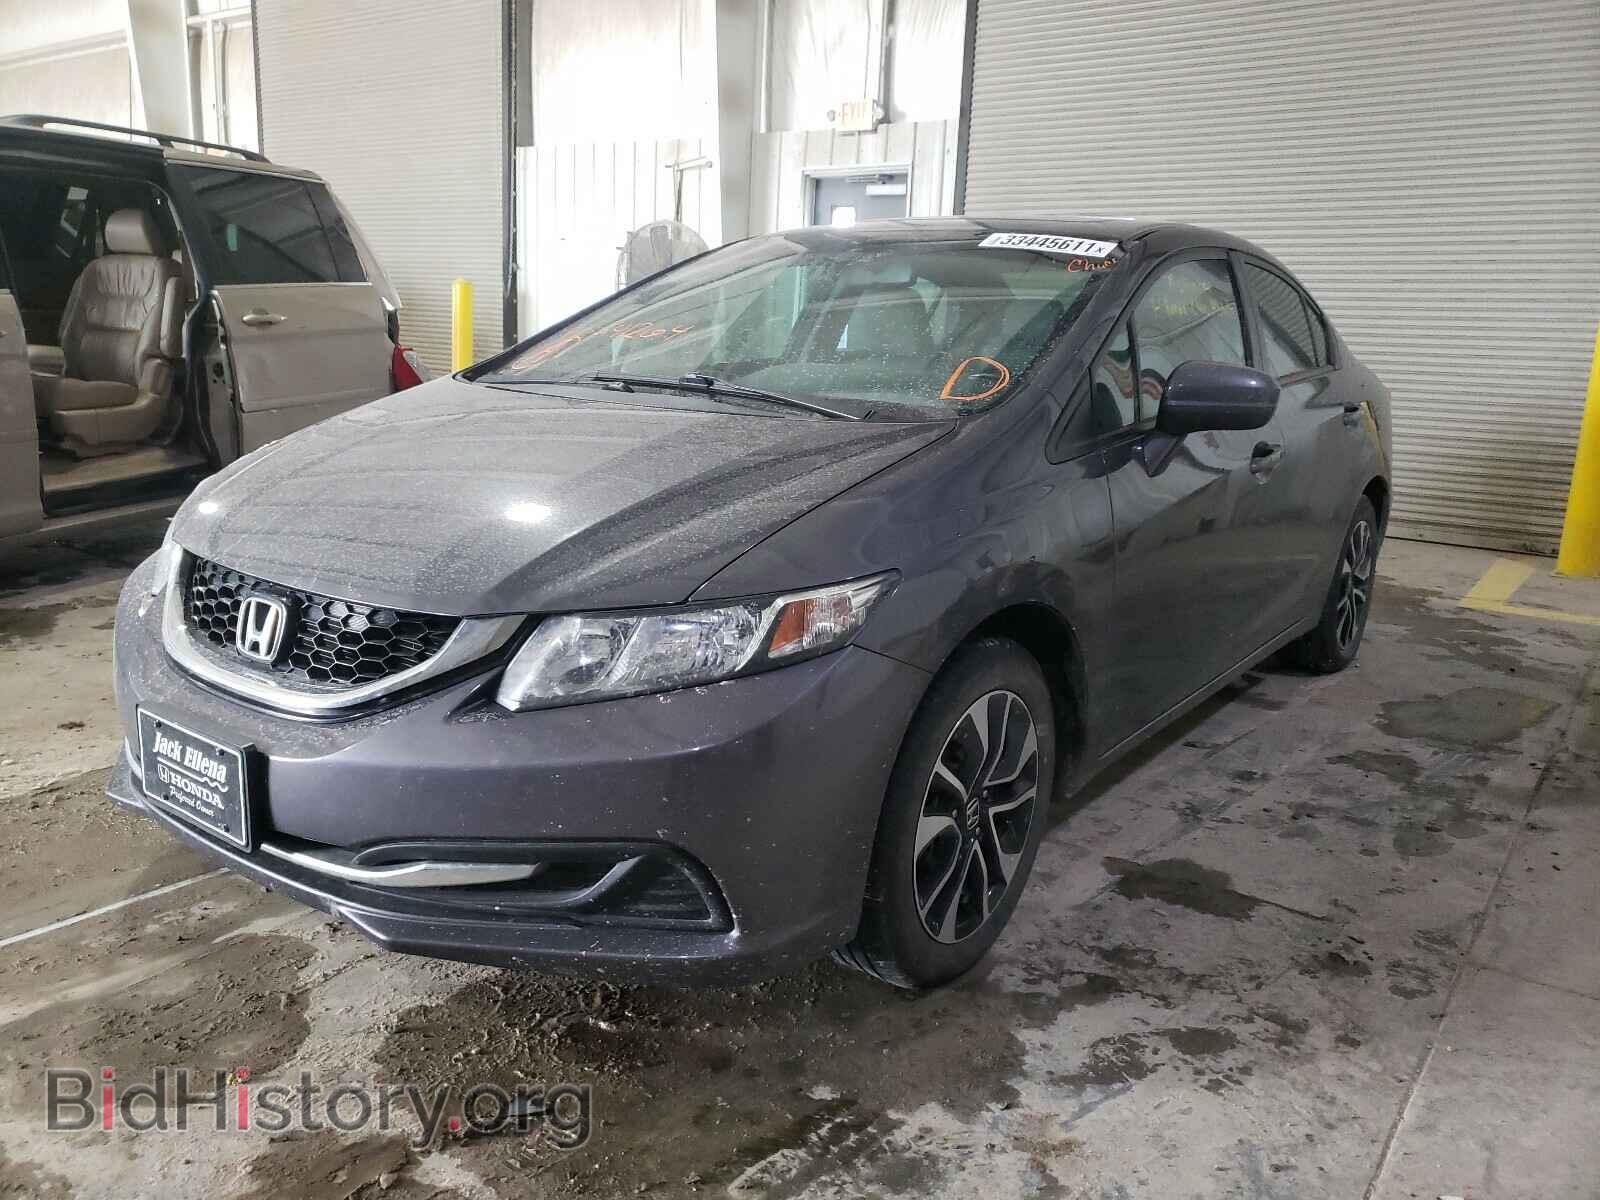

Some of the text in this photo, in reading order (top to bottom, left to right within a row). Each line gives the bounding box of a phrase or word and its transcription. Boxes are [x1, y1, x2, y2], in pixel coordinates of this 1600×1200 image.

[1000, 234, 1096, 253] 33445611
[153, 731, 227, 784] Jack Ellena
[169, 770, 225, 810] HONDA
